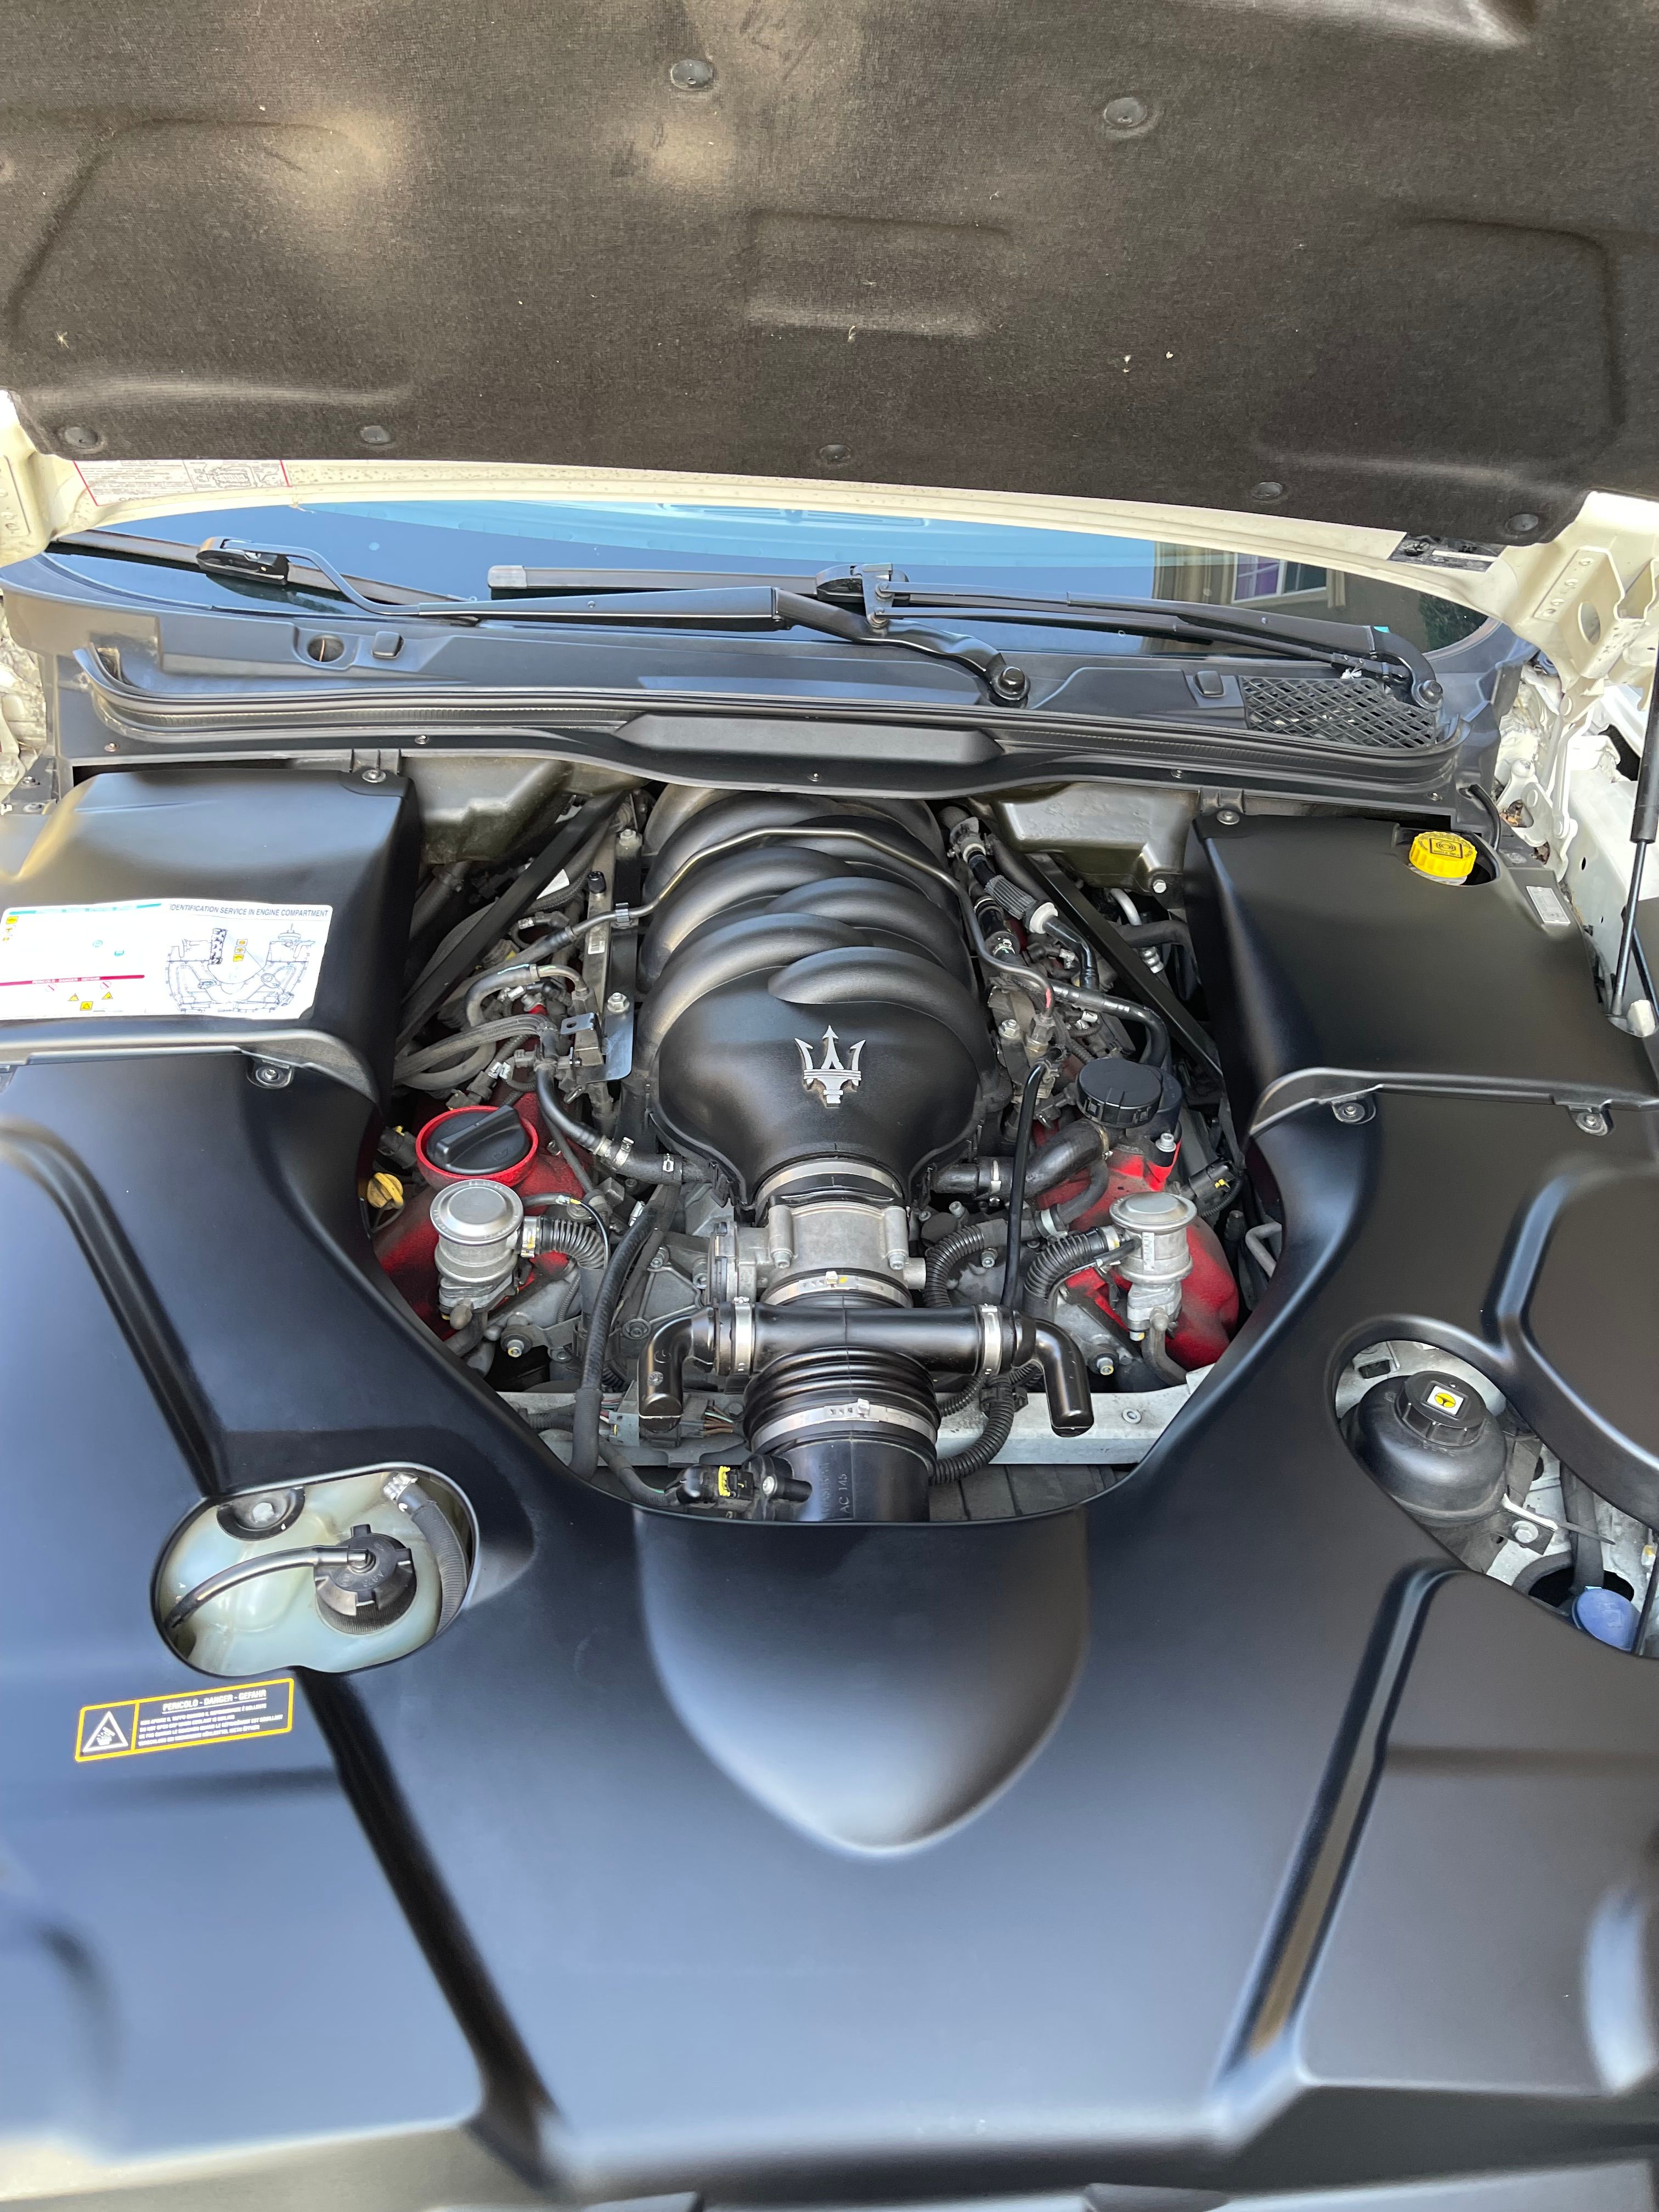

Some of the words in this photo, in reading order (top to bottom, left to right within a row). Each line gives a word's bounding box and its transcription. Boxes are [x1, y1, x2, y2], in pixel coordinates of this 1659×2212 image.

[170, 904, 219, 912] IDENTIFICATION
[838, 1474, 848, 1490] 145
[839, 1497, 850, 1514] AC
[163, 1699, 199, 1711] PERICOLO
[204, 1694, 233, 1705] DANGER
[238, 1690, 267, 1700] GEFAHR
